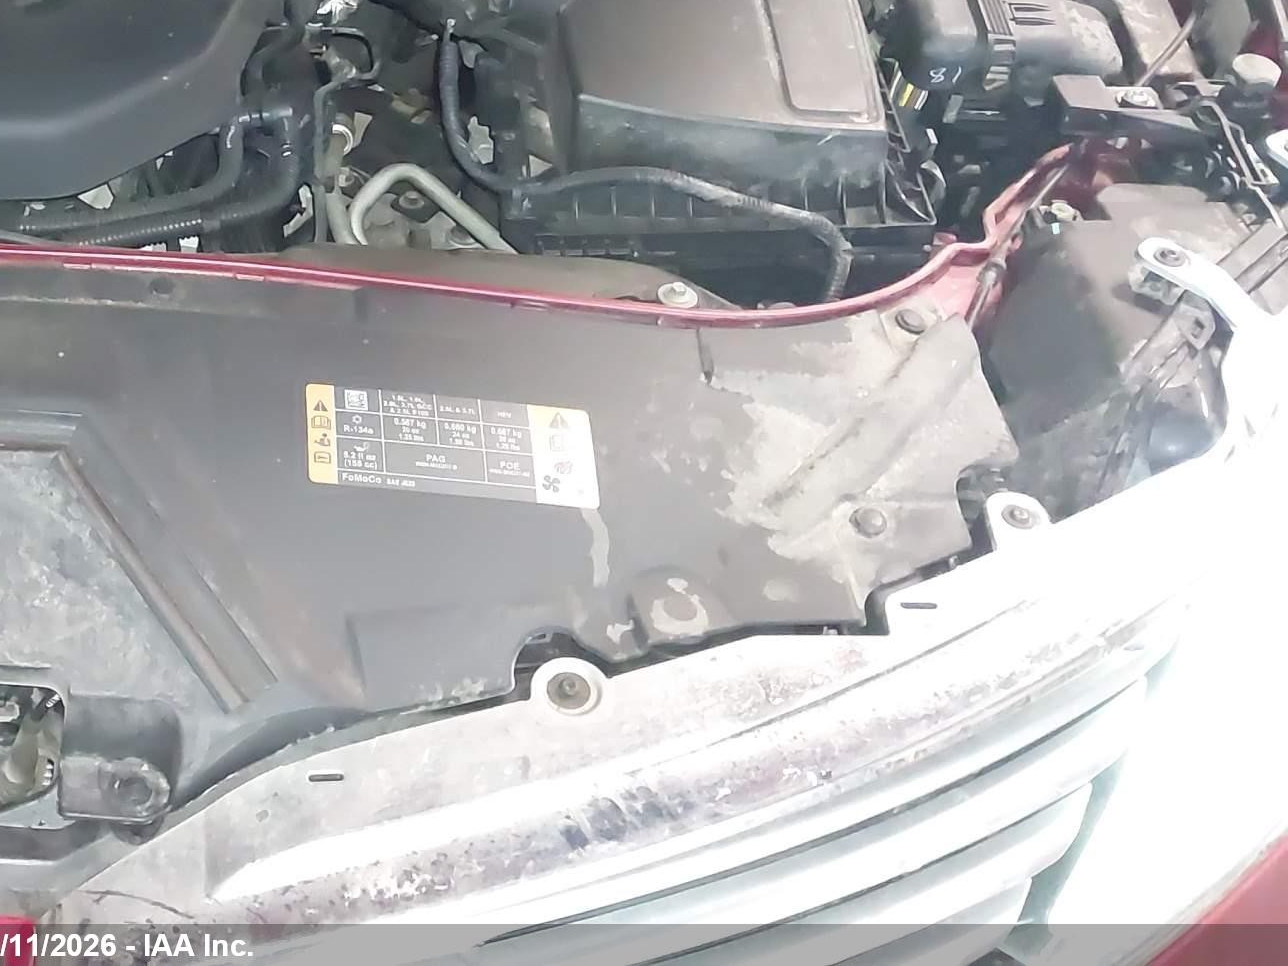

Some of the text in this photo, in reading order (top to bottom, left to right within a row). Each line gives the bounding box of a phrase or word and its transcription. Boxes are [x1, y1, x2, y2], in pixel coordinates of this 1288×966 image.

[343, 424, 374, 435] R-134a
[425, 453, 446, 463] PAG
[341, 472, 382, 484] FoMoCo
